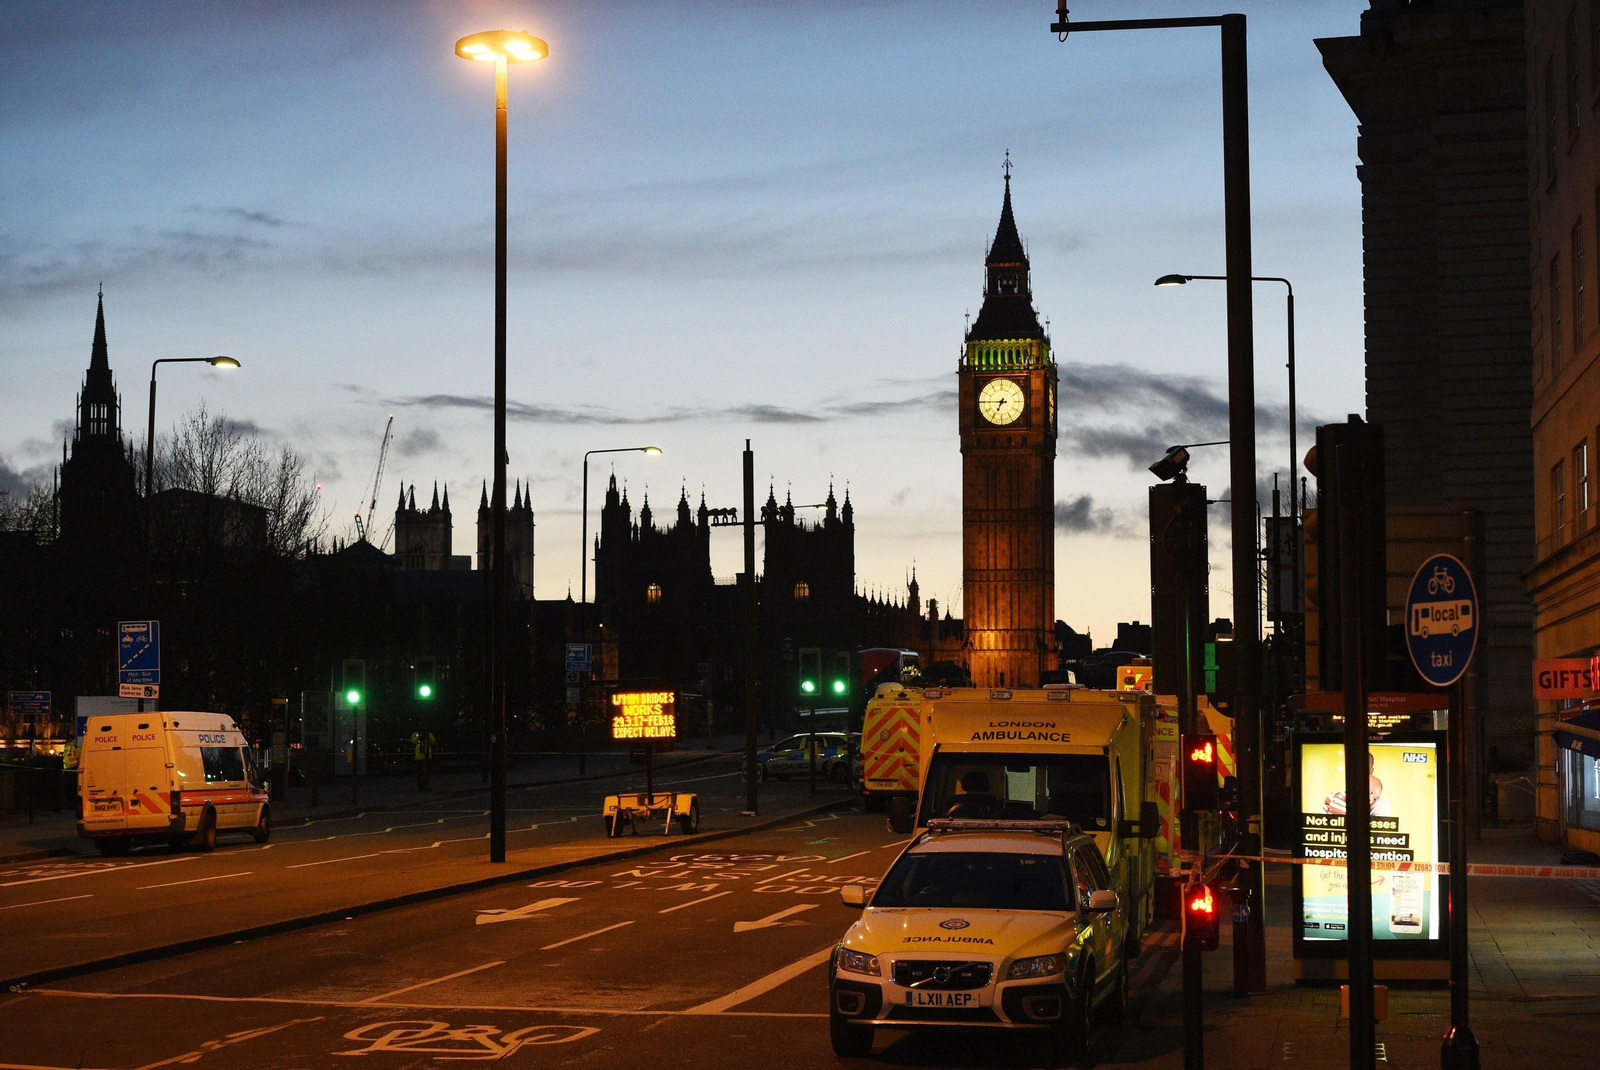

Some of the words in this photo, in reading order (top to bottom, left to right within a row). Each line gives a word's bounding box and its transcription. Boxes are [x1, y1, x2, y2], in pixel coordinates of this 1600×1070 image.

[1431, 606, 1459, 622] local
[1431, 651, 1452, 667] taxi
[1538, 669, 1592, 689] GIFTS
[640, 692, 674, 705] BRIDGES
[623, 704, 662, 716] WORKS
[613, 727, 643, 738] EXPECT
[645, 726, 676, 737] DELAYS
[971, 731, 1071, 743] AMBULANCE
[199, 734, 226, 743] POLICE
[1403, 753, 1427, 763] NHS
[772, 762, 809, 770] POLIC
[1306, 816, 1328, 826] Not
[1330, 817, 1345, 827] all
[1305, 831, 1328, 841] and
[1376, 835, 1406, 845] need
[610, 869, 751, 880] STN
[918, 992, 942, 1006] LX11
[946, 993, 972, 1006] AEP
